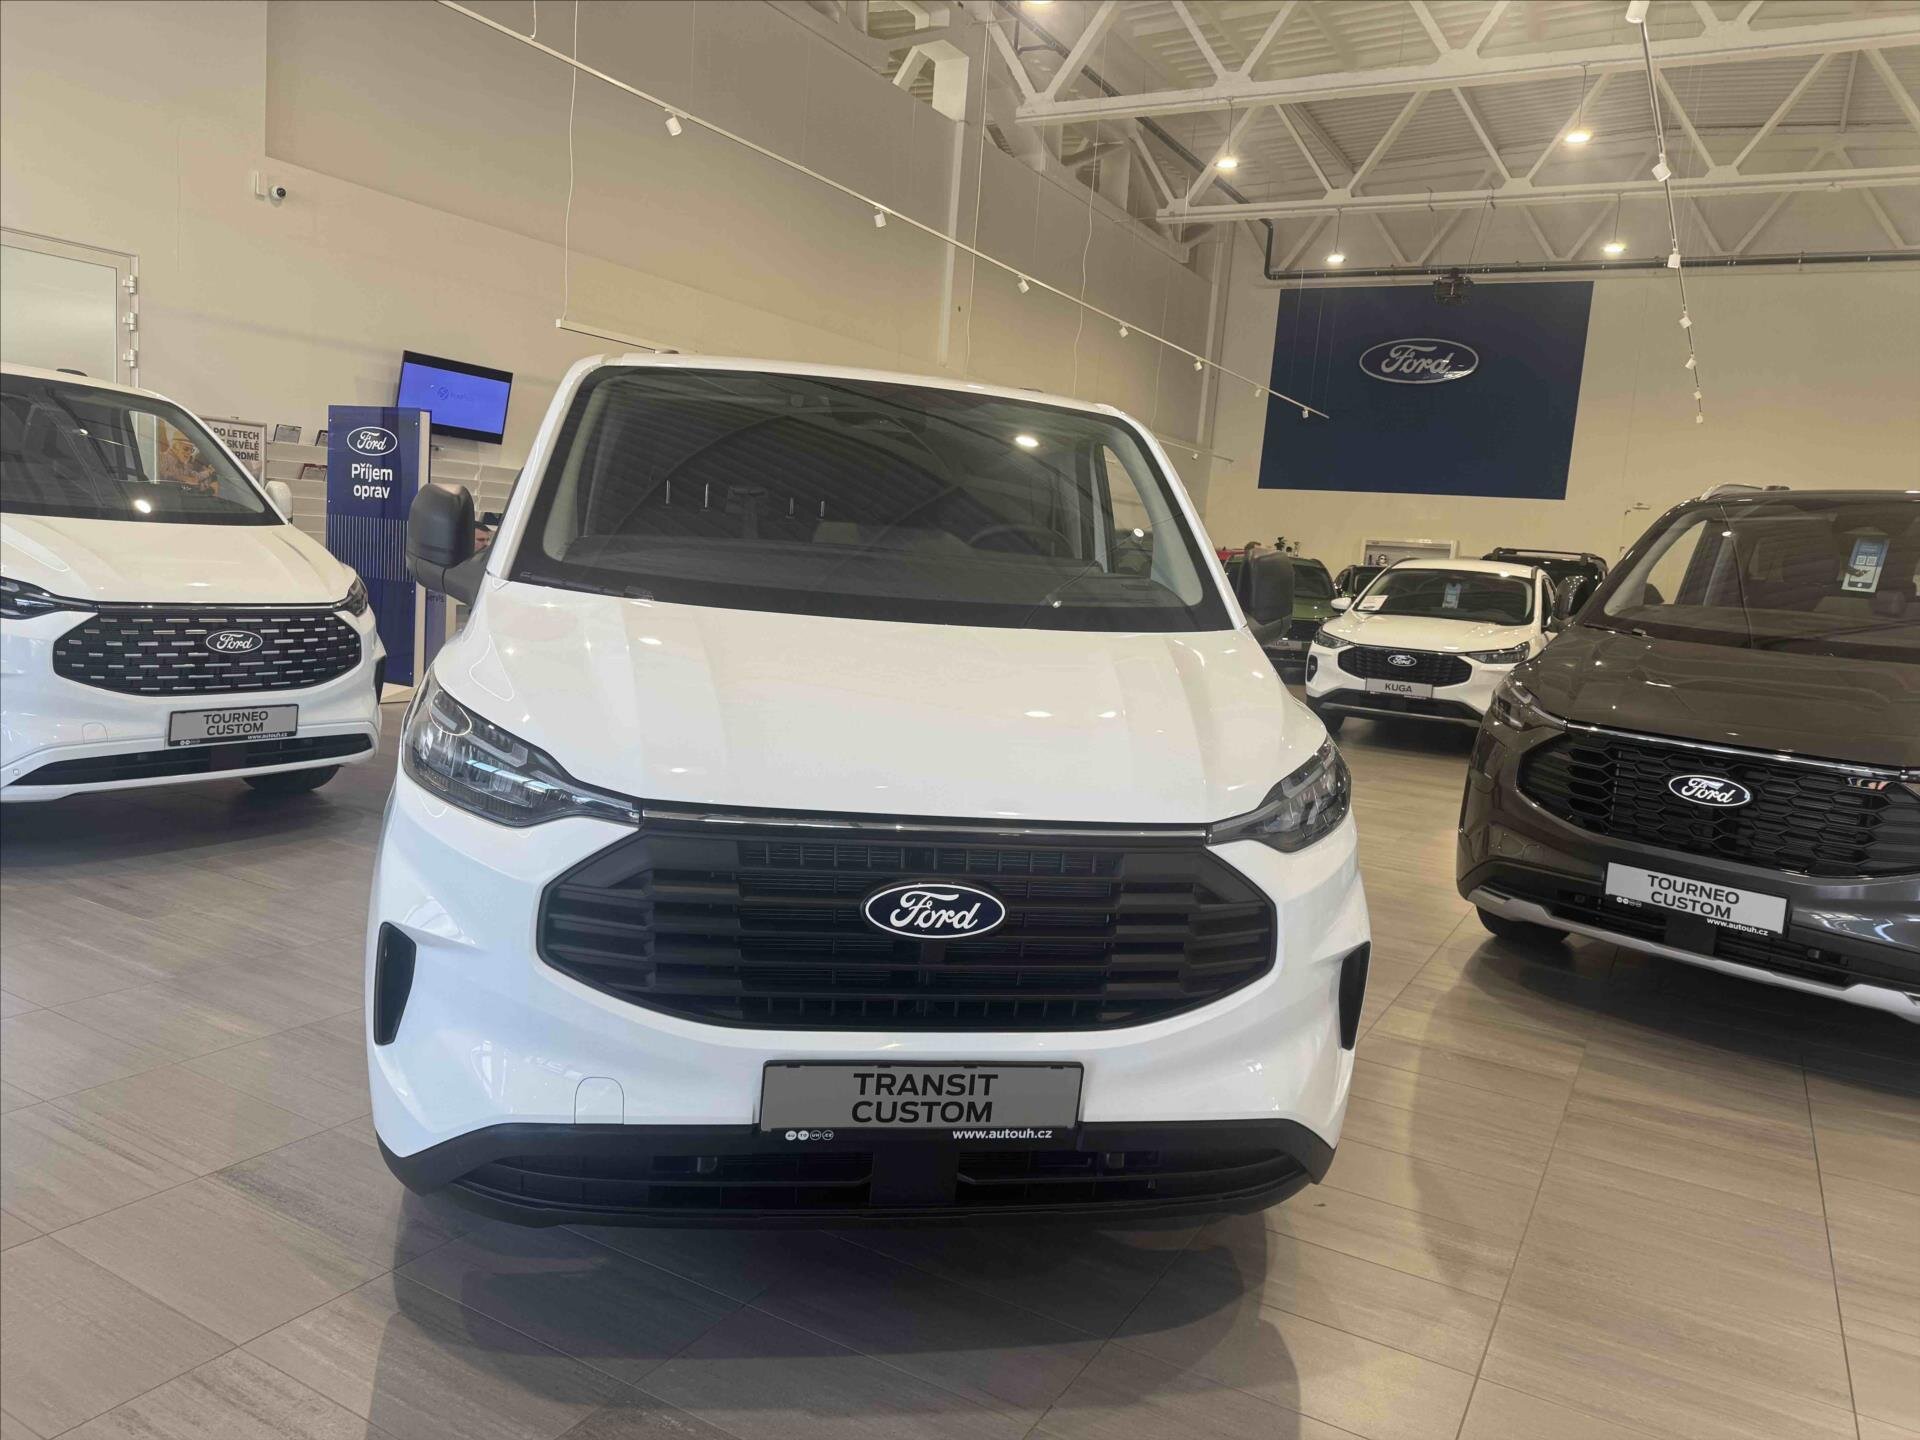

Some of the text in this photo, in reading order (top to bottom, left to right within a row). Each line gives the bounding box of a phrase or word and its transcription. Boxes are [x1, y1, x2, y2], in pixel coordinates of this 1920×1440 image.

[1381, 344, 1455, 373] Ford
[227, 429, 260, 440] LETECH
[356, 430, 388, 451] Ford
[351, 462, 393, 483] Příjem
[353, 484, 391, 500] oprav
[216, 633, 253, 650] Ford
[1392, 654, 1412, 665] Ford
[1384, 682, 1413, 693] KUGA
[203, 710, 269, 725] TOURNEO
[206, 722, 264, 736] CUSTOM
[1681, 777, 1737, 803] Ford
[1647, 873, 1740, 905] TOURNEO
[889, 889, 982, 930] Ford
[1650, 890, 1732, 920] CUSTOM
[1706, 917, 1769, 937] www.autouh.cz
[853, 1072, 998, 1097] TRANSIT
[851, 1100, 993, 1124] CUSTOM
[952, 1128, 1053, 1140] www.autouh.cz
